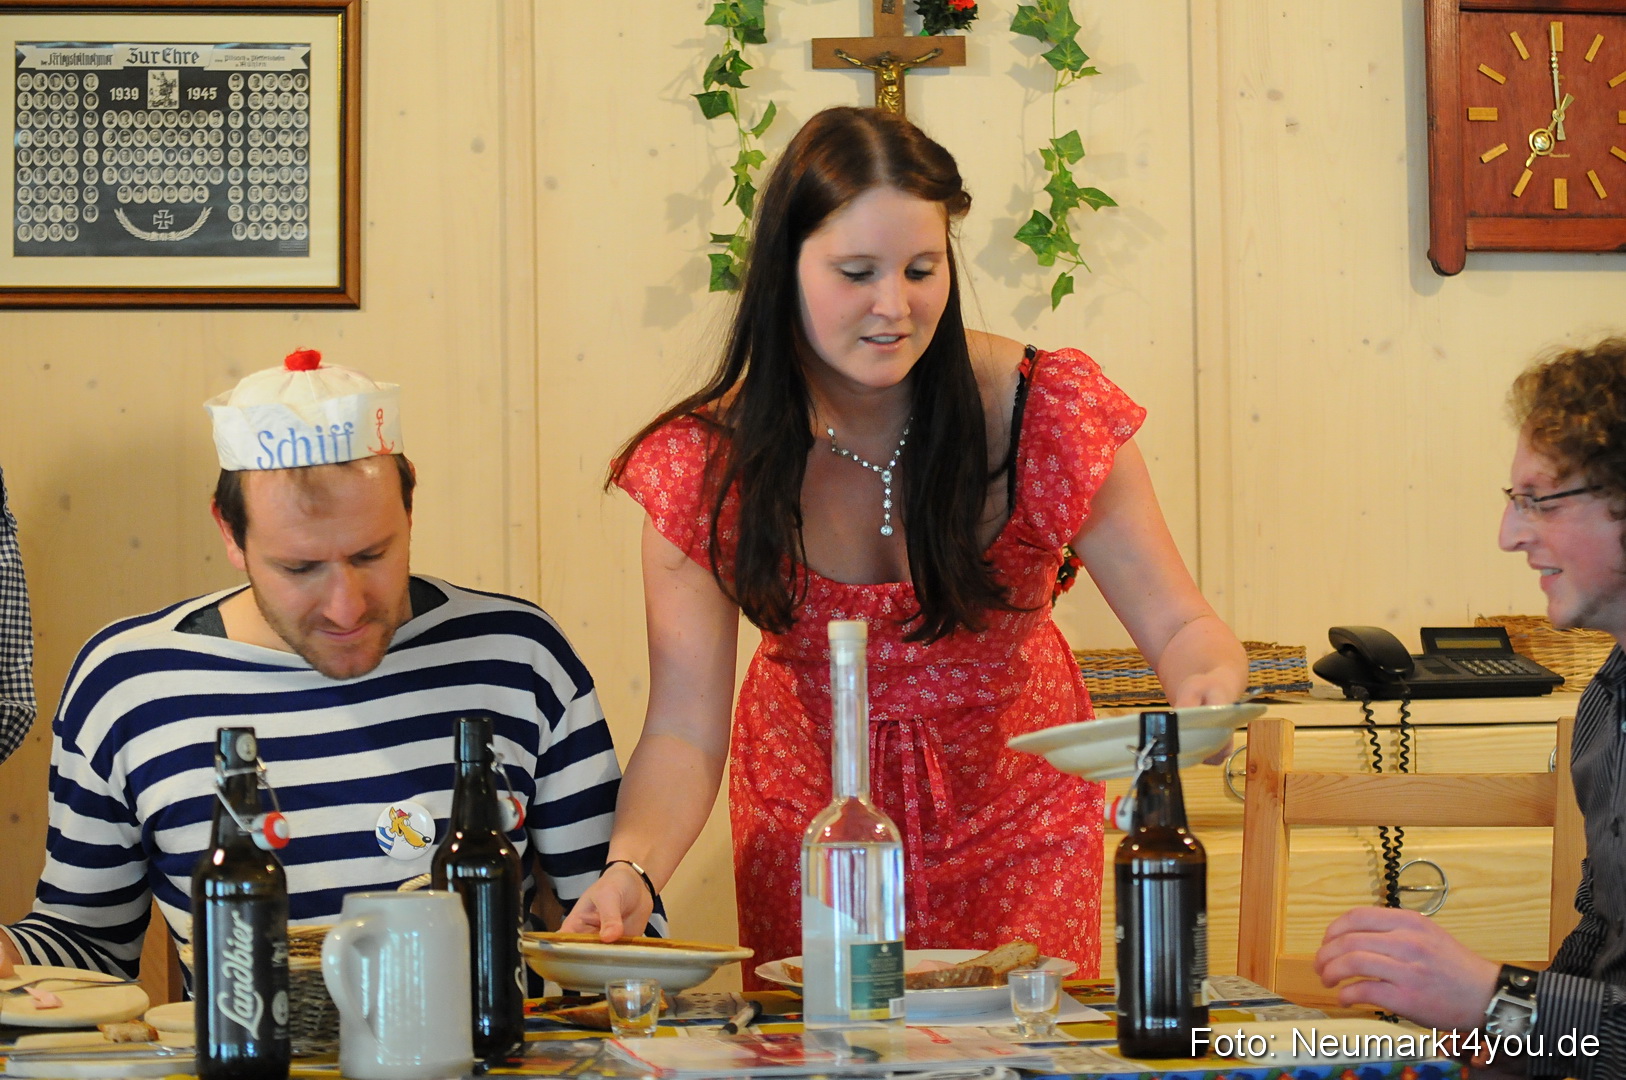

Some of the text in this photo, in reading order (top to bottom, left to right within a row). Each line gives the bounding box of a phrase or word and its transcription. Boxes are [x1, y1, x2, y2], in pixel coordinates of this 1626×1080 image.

[126, 47, 160, 65] Zur
[162, 47, 200, 65] Ehre
[109, 86, 218, 101] 1939 1945
[256, 421, 354, 470] Schiff
[217, 909, 264, 1041] Landbier
